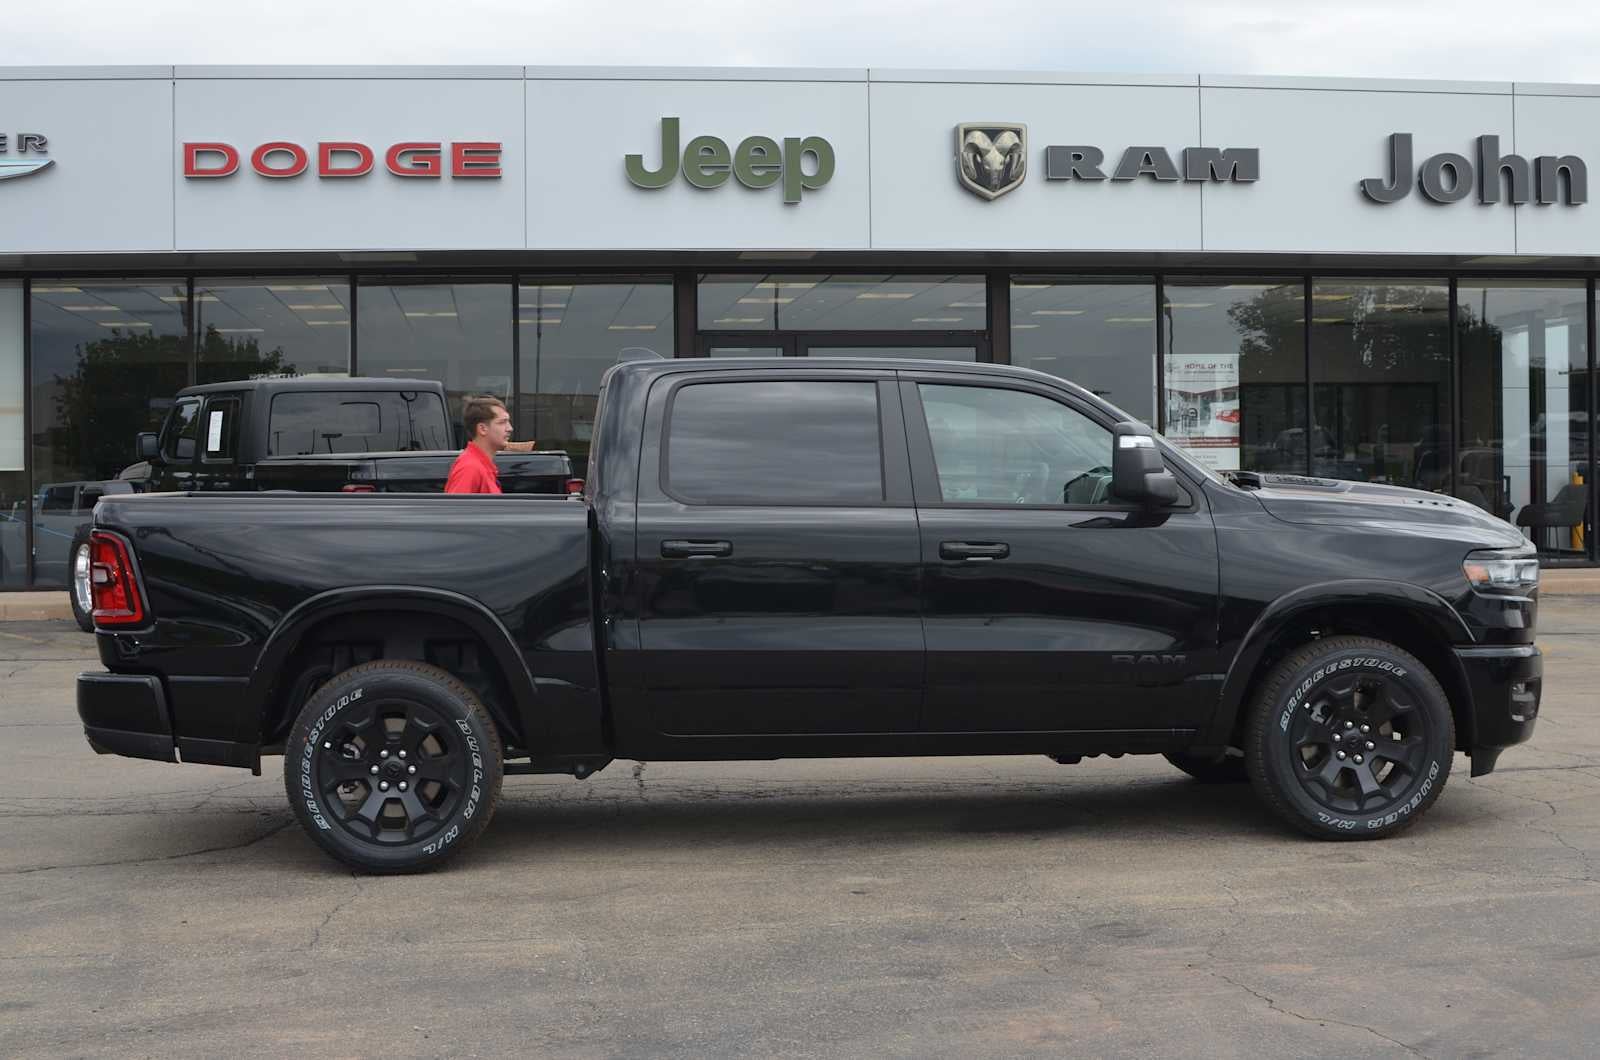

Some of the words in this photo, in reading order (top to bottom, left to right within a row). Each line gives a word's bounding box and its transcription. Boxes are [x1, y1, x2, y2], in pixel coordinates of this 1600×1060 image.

[183, 141, 503, 179] DODGE
[624, 117, 835, 205] Jeep
[1046, 145, 1260, 183] RAM
[1359, 132, 1588, 206] John
[1111, 654, 1188, 665] RAM
[1279, 657, 1408, 733] BRIDGESTONE
[300, 687, 364, 831] BRIDGESTONE
[455, 718, 483, 821] DUELER
[1367, 760, 1440, 830] DUELER
